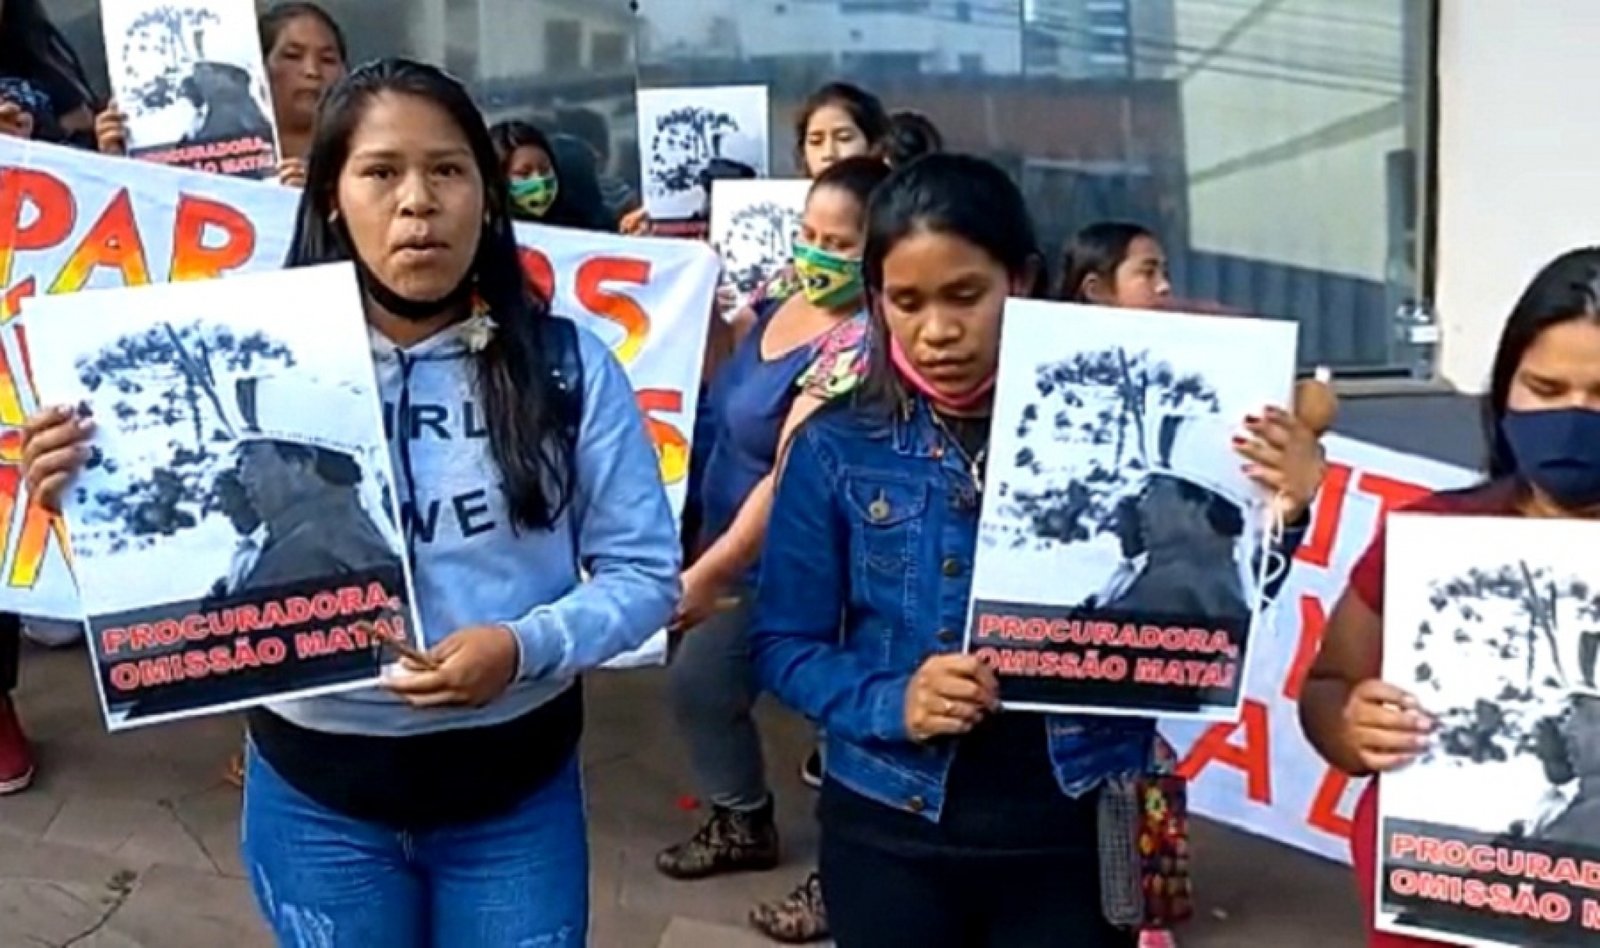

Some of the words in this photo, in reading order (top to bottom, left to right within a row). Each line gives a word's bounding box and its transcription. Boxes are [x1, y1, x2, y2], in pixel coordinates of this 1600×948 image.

[102, 581, 399, 654] PROCURADORA,
[977, 613, 1239, 659] PROCURADORA,
[110, 636, 286, 690] OMISSÃO
[295, 616, 407, 659] MATA!
[975, 646, 1127, 681] OMISSÃO
[1134, 656, 1236, 688] MATA!
[1390, 868, 1571, 923] OMISSÃO
